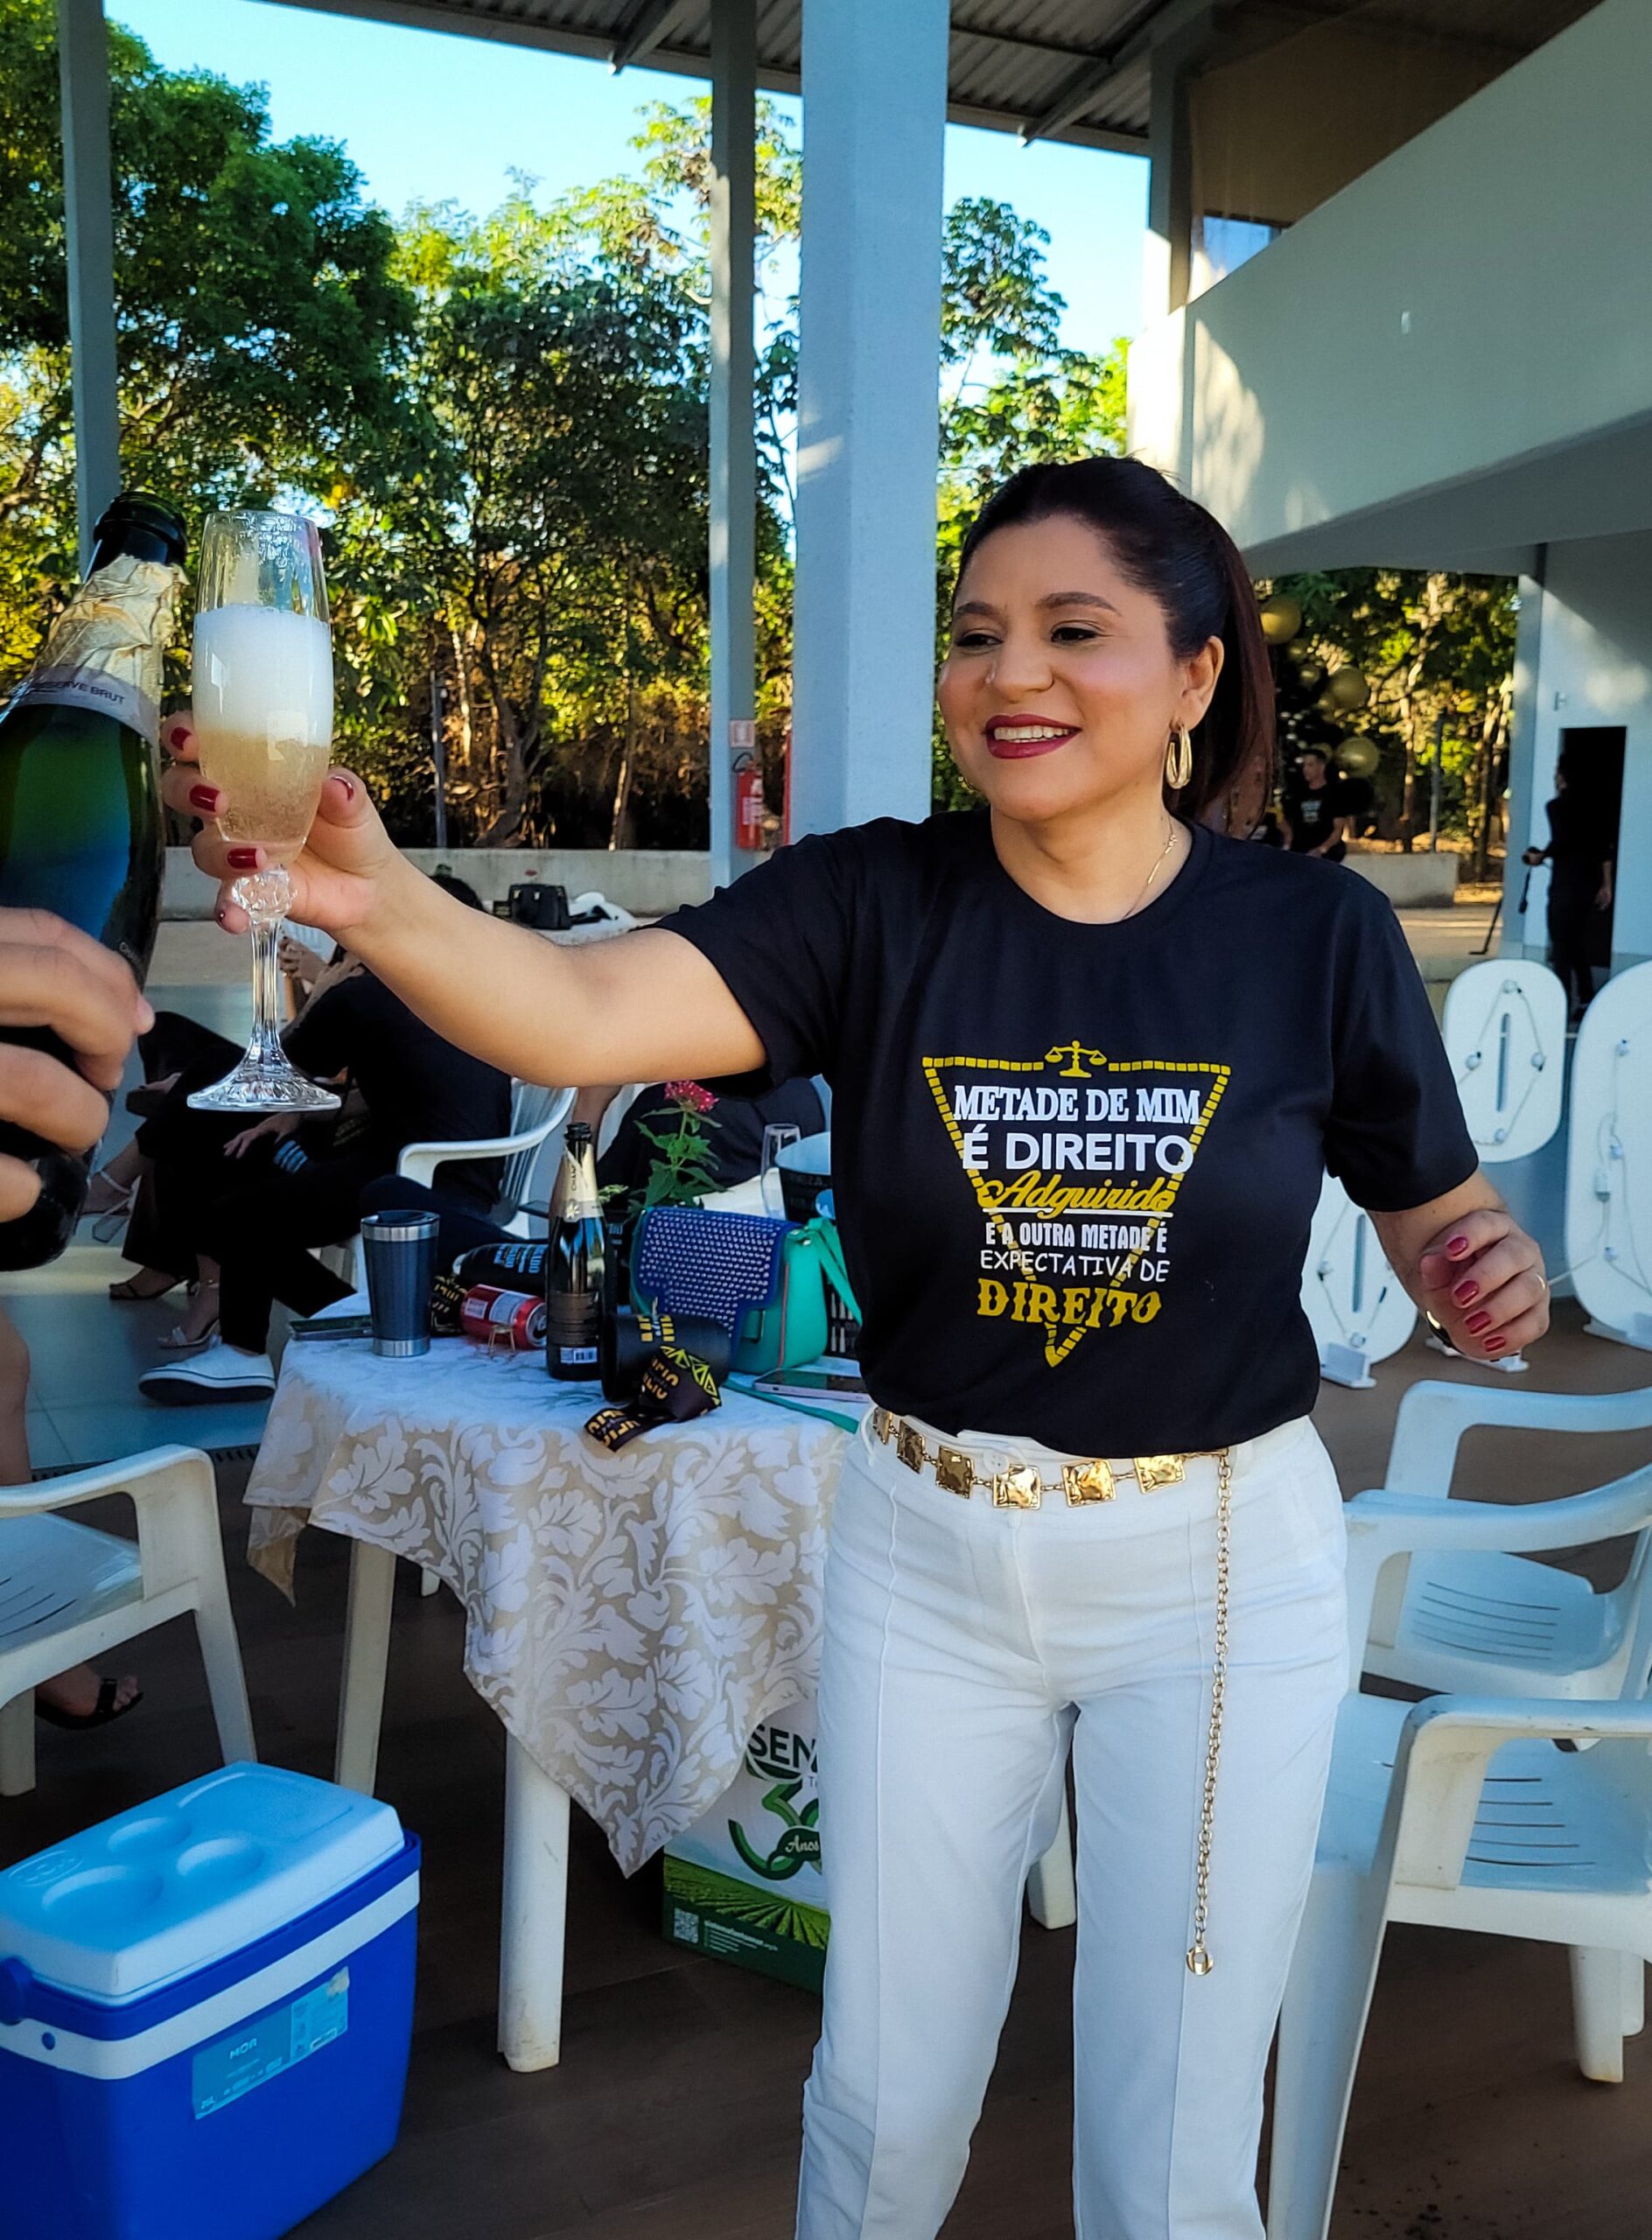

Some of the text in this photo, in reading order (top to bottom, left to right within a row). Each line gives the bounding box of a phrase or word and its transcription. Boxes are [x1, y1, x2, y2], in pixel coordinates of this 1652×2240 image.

[90, 686, 125, 704] BRUT
[953, 1085, 1200, 1125] METADE DE MIM
[962, 1123, 1194, 1174] É DIREITO
[985, 1221, 1168, 1254] E A OUTRA METADE É
[980, 1249, 1171, 1283] EXPECTATIVA DE
[976, 1278, 1162, 1329] DIREITO
[747, 1724, 818, 1774] SEN
